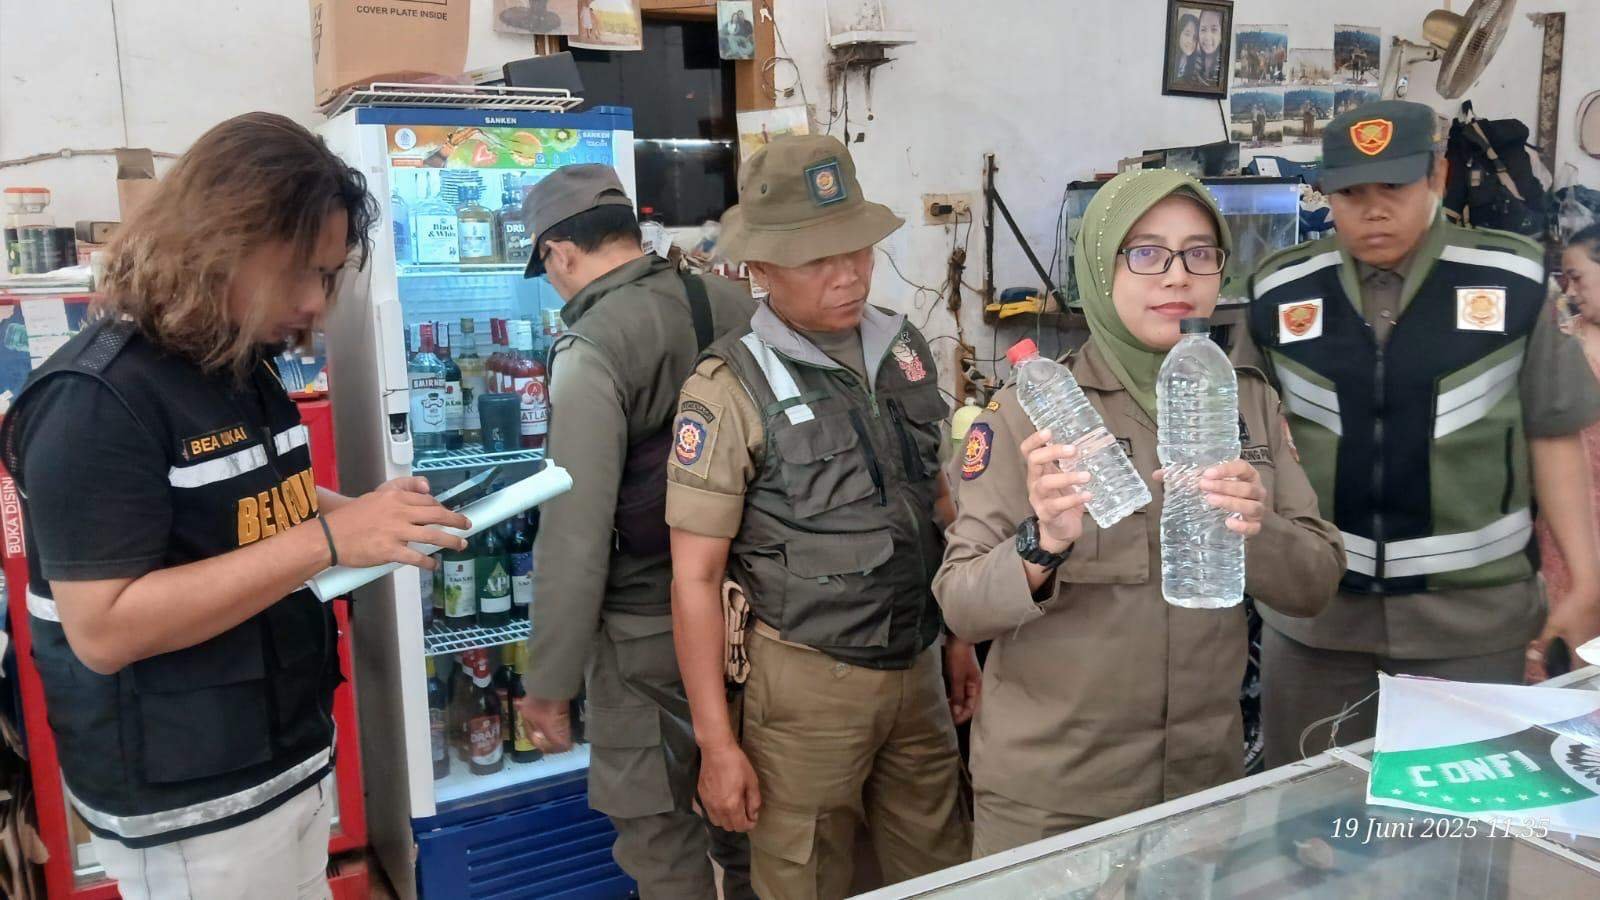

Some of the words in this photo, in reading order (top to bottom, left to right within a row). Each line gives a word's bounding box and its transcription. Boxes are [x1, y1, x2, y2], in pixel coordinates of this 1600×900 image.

[357, 5, 388, 15] COVER
[391, 8, 418, 17] PLATE
[420, 11, 448, 21] INSIDE
[583, 131, 610, 139] SANKEN
[433, 223, 454, 231] Black
[191, 435, 221, 455] BEA
[2, 476, 17, 514] DISINI
[238, 486, 290, 546] BEA
[7, 517, 21, 554] BUKA
